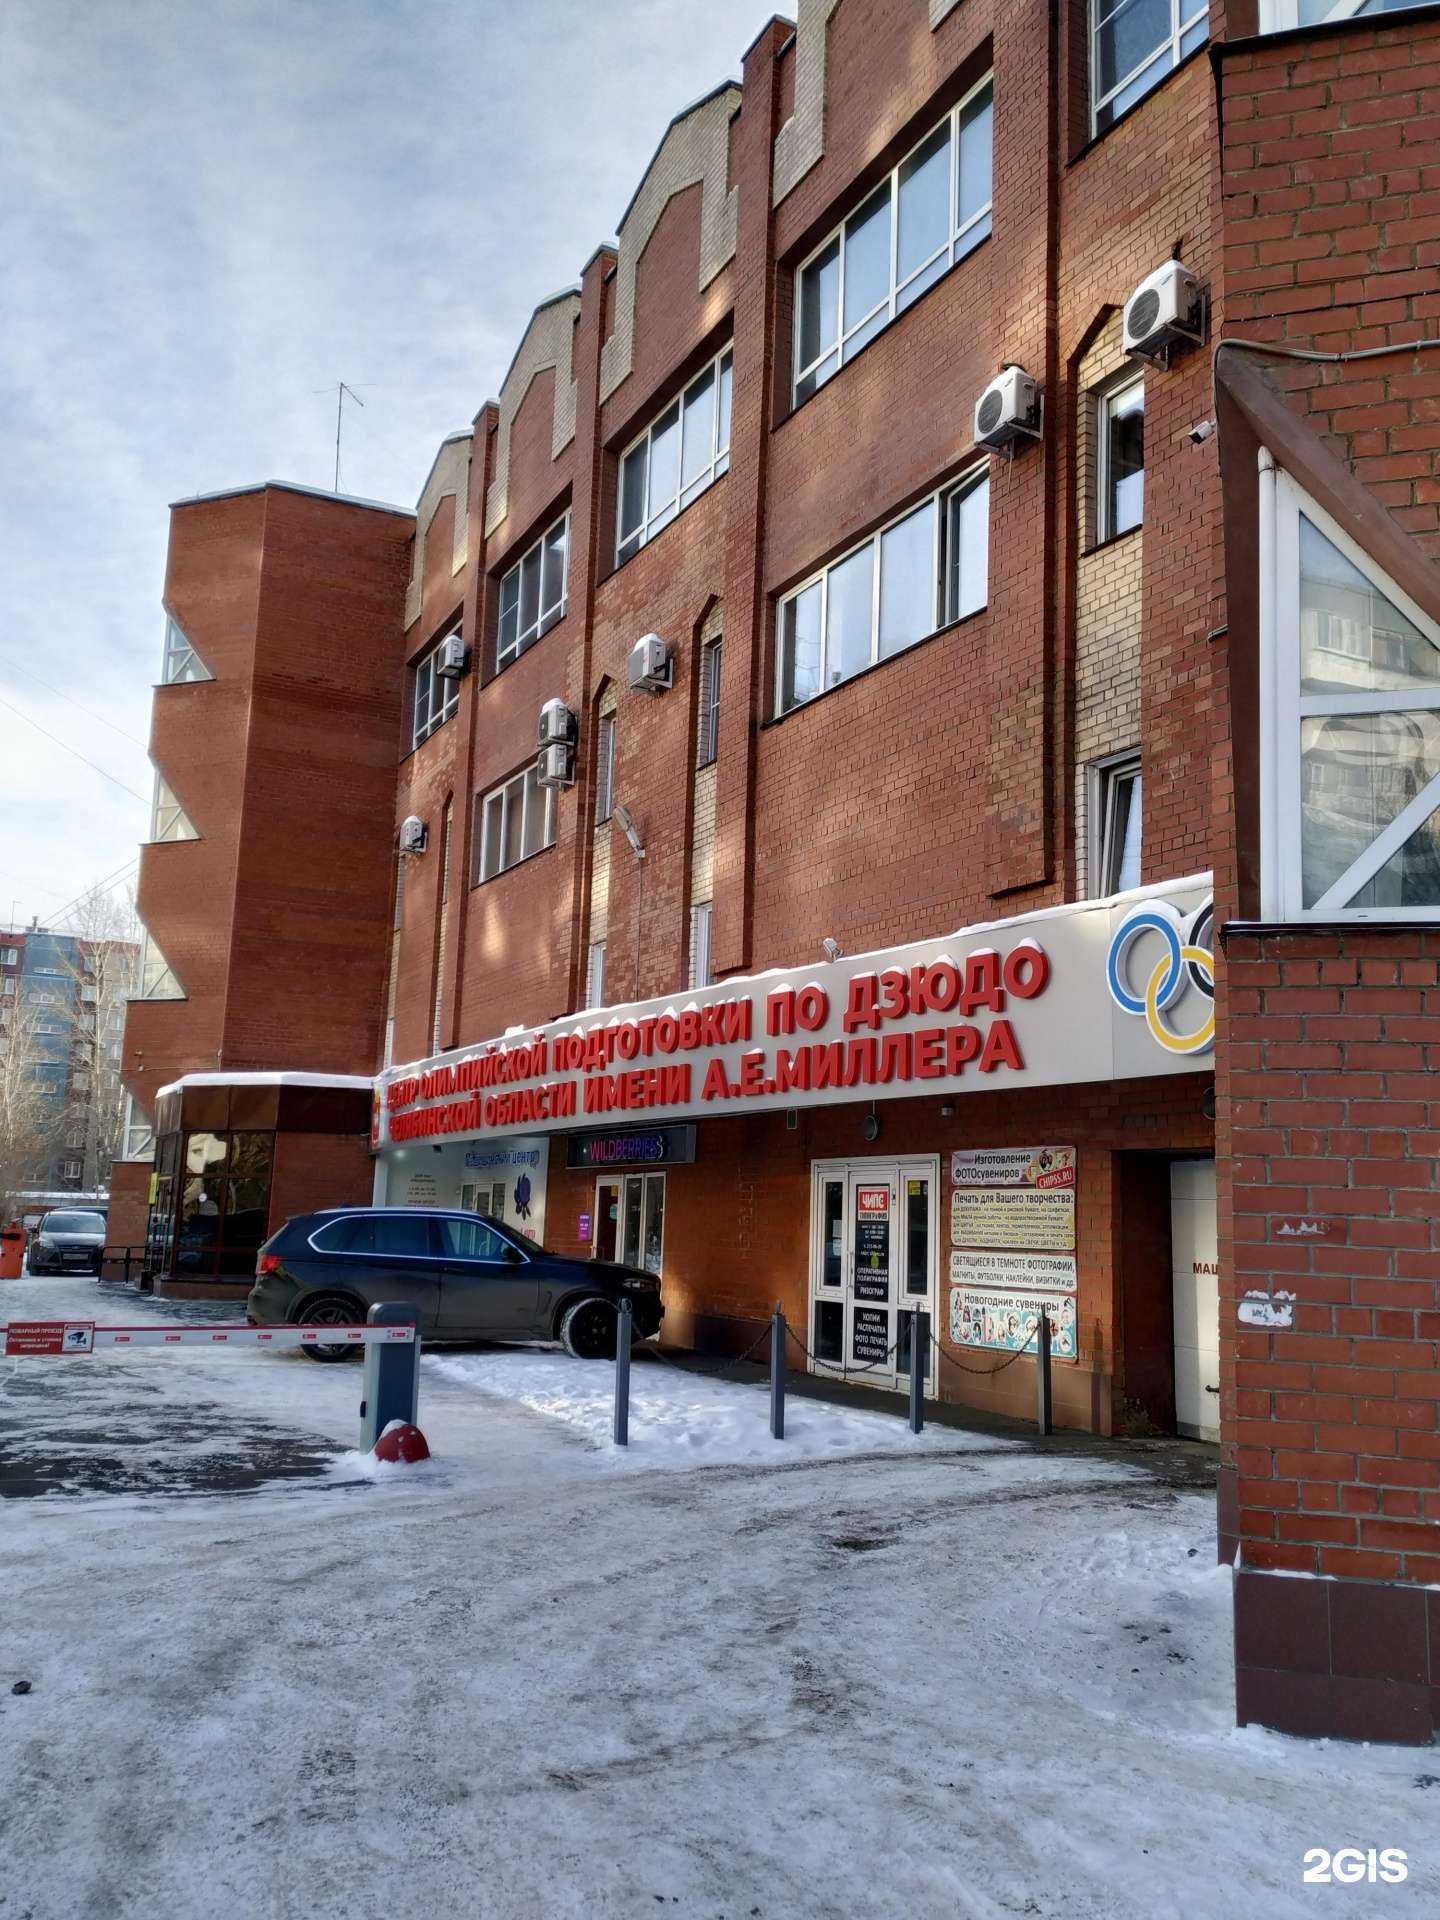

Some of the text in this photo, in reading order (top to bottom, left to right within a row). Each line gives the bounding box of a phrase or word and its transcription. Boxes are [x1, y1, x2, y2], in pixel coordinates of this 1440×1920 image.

[387, 945, 1049, 1112] ЦЕНТР ОЛИМПИЙСКОЙ ПОДГОТОВКИ ПО ДЗЮДО
[485, 1081, 576, 1126] ОБЛАСТИ
[583, 1063, 691, 1113] ИМЕНИ
[701, 1020, 1025, 1100] А.Е.МИЛЛЕРА
[591, 1136, 663, 1161] WILDBERRIES
[975, 1154, 1031, 1165] Изготовление
[955, 1168, 1019, 1180] ФОТОсувениров
[1038, 1171, 1073, 1188] CHIPSS.RU
[862, 1193, 884, 1209] ЧИПС
[954, 1193, 1073, 1205] Печать для Вашего творчества:
[952, 1256, 1075, 1273] СВЕТЯЩИЕСЯ В ТЕМНОТЕ ФОТОГРАФИИ,
[857, 1275, 888, 1283] ПОЛИГРАФИЯ
[1036, 1275, 1060, 1285] ВИЗИТКИ
[964, 1293, 1060, 1311] Новогодние сувениры
[862, 1312, 881, 1322] КОПИИ
[857, 1323, 886, 1334] РАСПЕЧАТКА
[855, 1334, 888, 1346] ФОТО ПЕЧАТЬ
[857, 1346, 885, 1357] СУВЕНИРЫ
